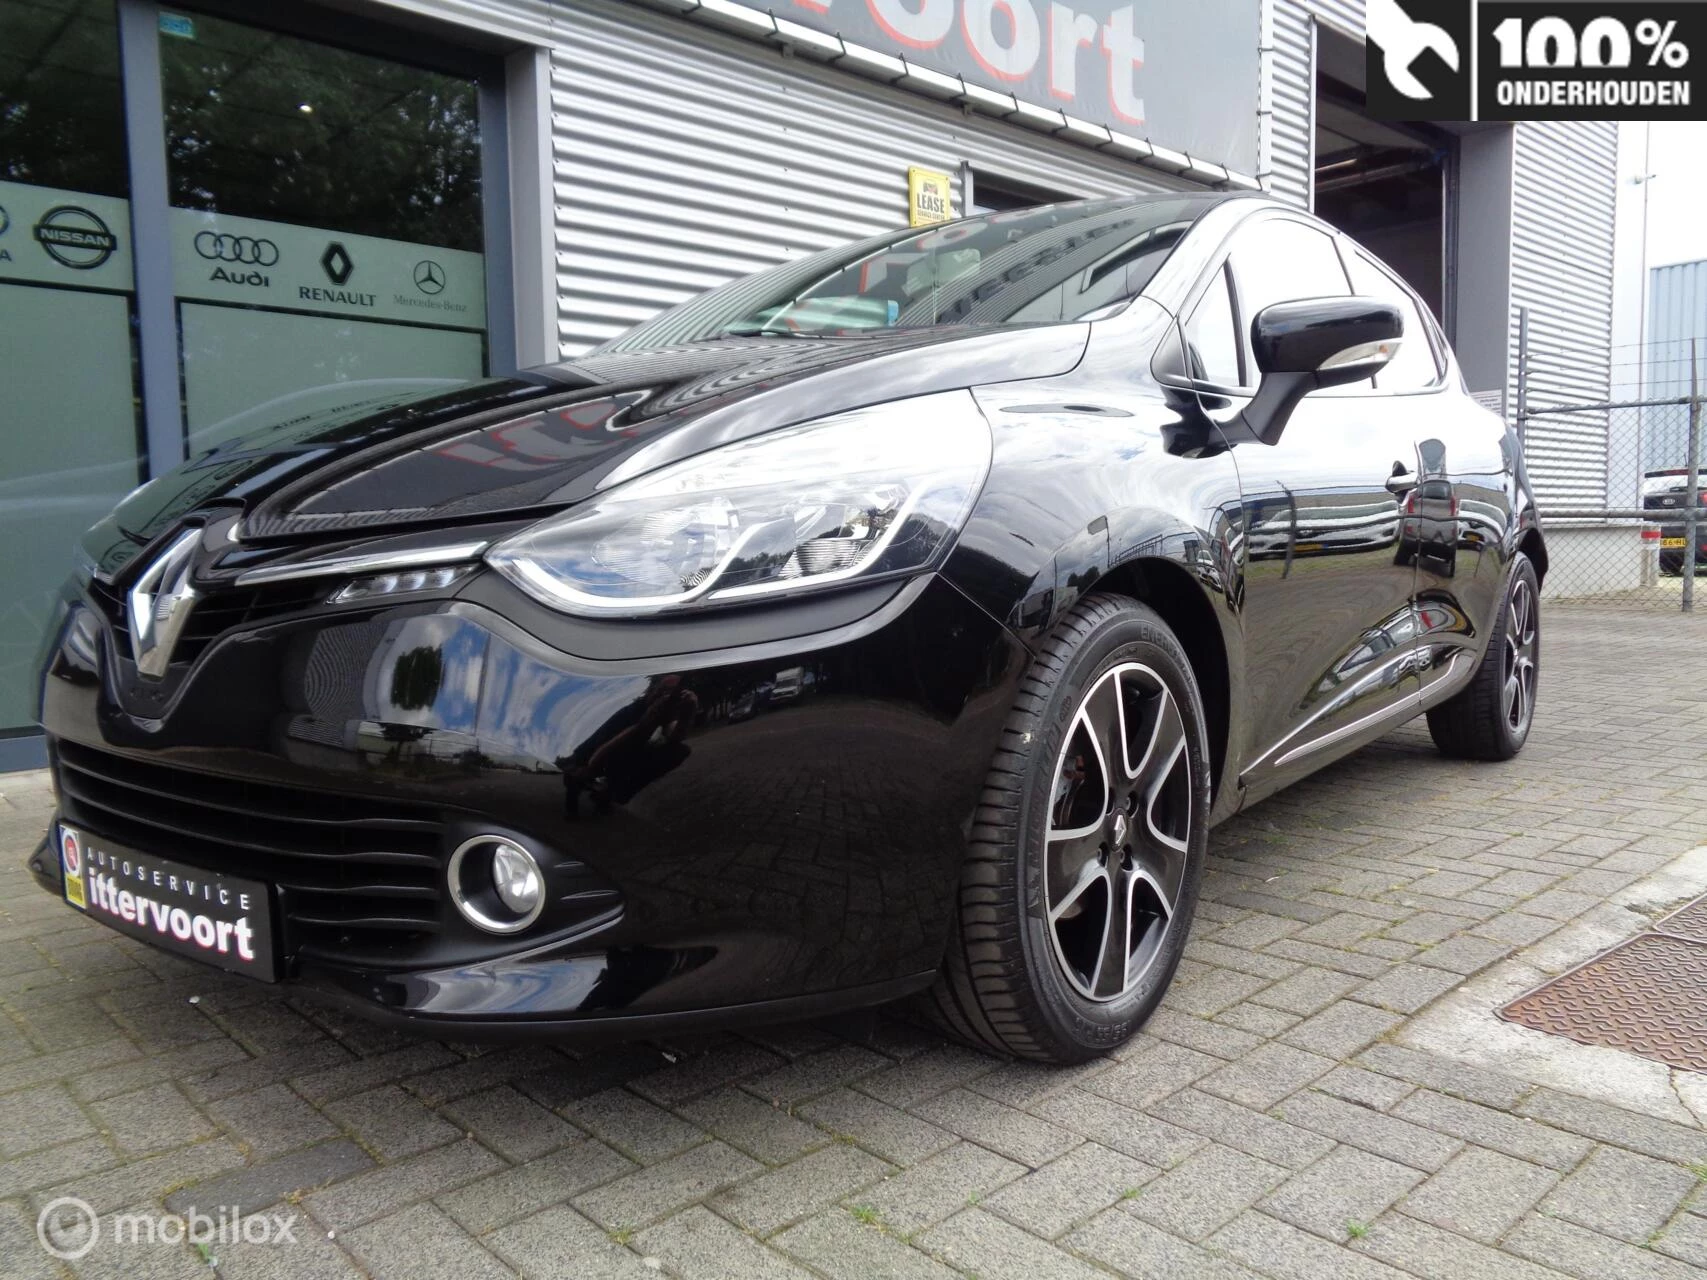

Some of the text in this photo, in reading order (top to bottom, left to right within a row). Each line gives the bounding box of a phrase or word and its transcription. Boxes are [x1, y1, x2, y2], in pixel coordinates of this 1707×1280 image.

[793, 0, 1146, 125] ort
[917, 192, 945, 213] LEASE
[40, 228, 111, 248] NISSAN
[209, 266, 270, 288] Audi
[299, 286, 377, 307] RENAULT
[393, 294, 468, 313] Mercedes-Benz
[87, 846, 250, 910] AUTOSERVICE
[88, 867, 254, 961] ittervoort
